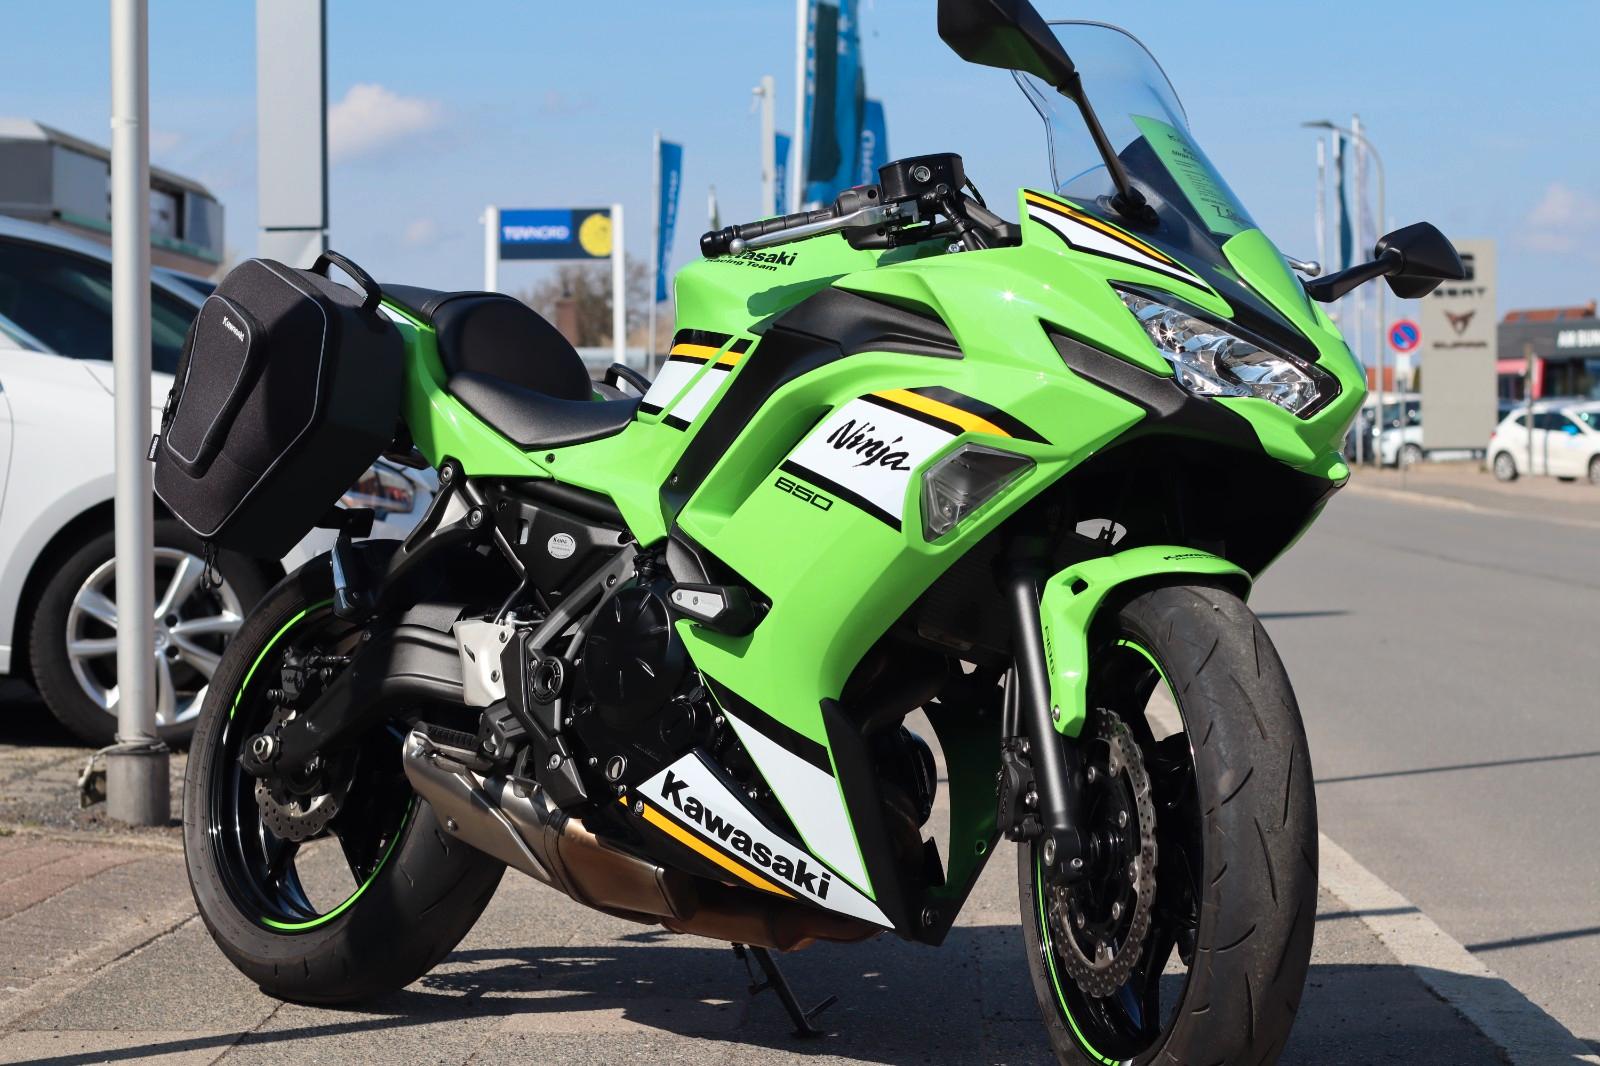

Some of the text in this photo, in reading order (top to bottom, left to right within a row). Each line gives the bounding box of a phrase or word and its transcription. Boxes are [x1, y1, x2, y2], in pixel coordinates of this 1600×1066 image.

[747, 260, 778, 272] Team
[1432, 287, 1486, 298] SEAT
[826, 419, 911, 471] Ninja
[774, 476, 834, 512] 650
[661, 770, 831, 901] Kawasaki
